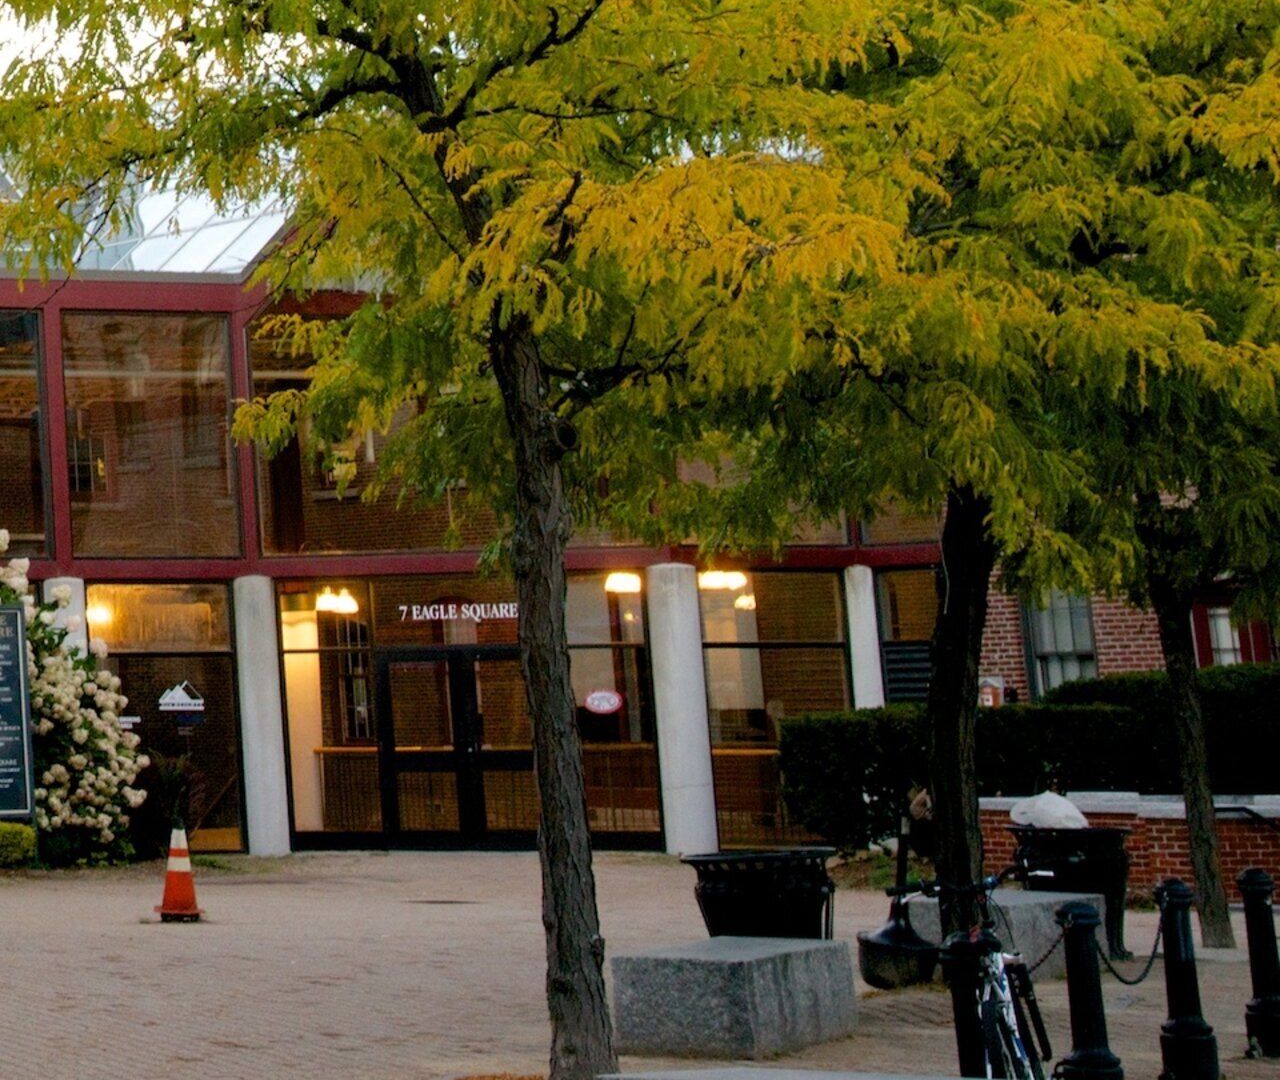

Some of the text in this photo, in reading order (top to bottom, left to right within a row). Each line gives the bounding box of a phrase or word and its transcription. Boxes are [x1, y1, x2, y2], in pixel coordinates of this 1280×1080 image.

[398, 602, 518, 622] 7 EAGLE SQUARE
